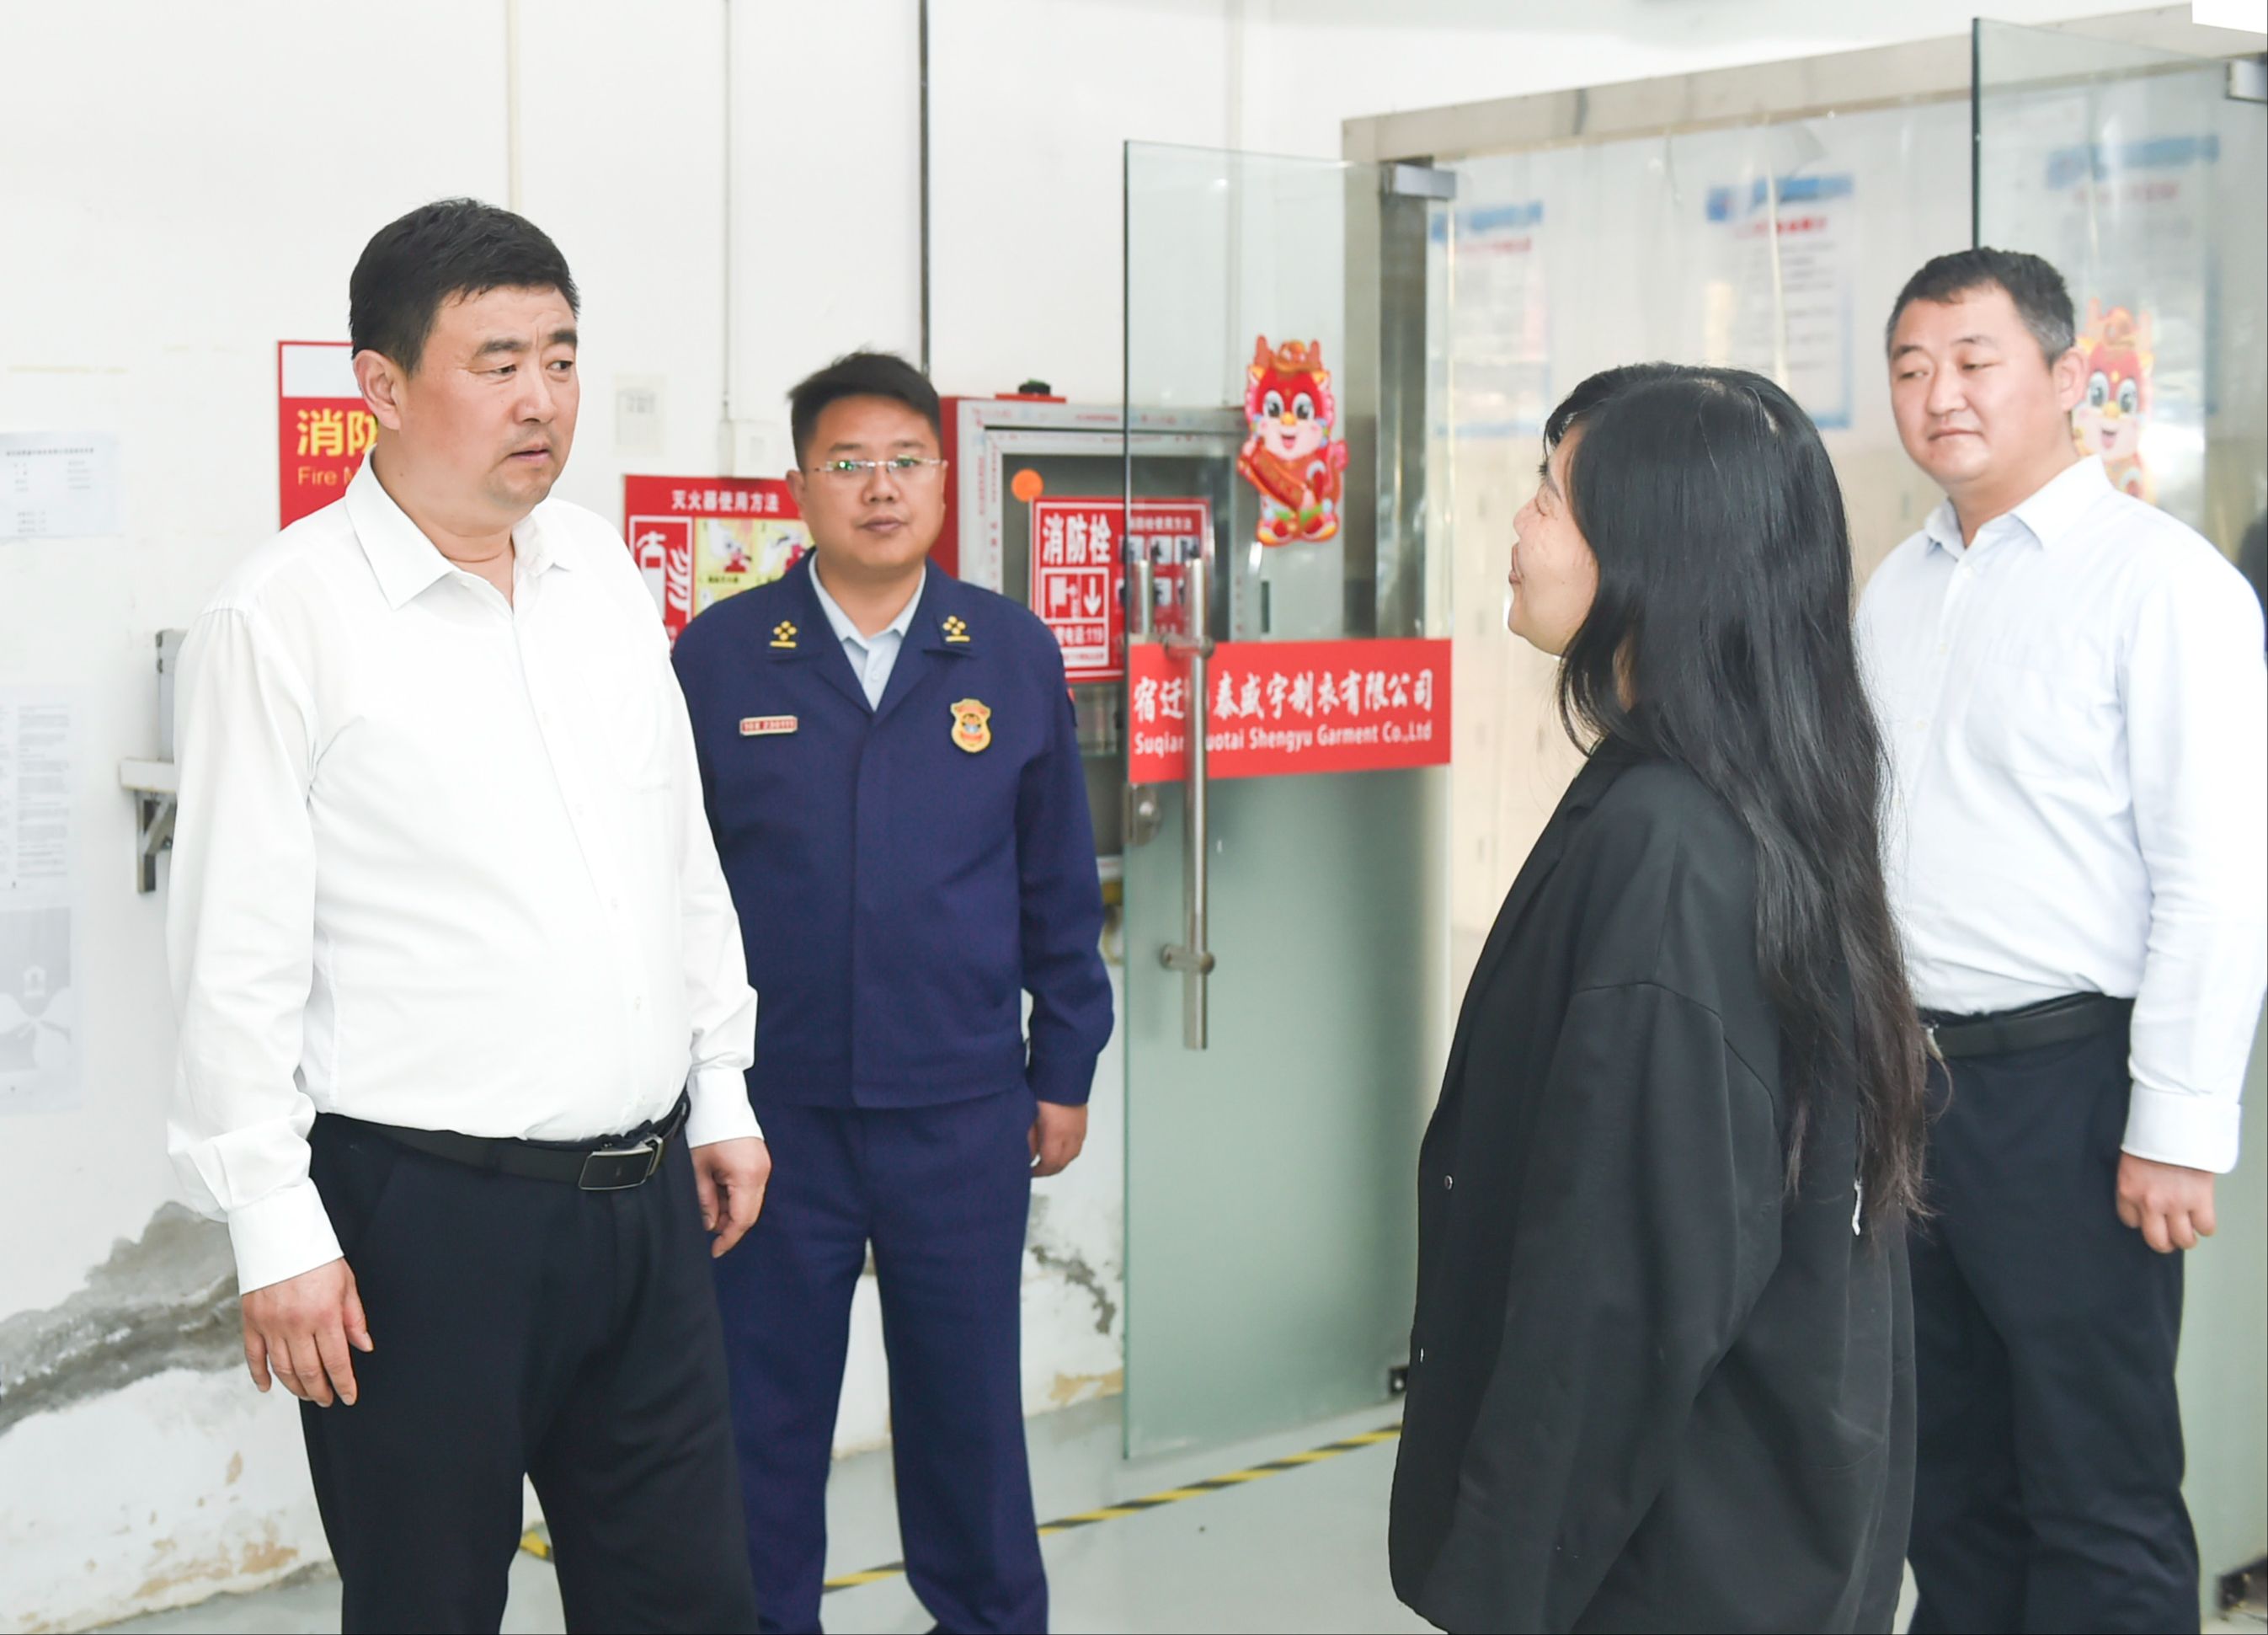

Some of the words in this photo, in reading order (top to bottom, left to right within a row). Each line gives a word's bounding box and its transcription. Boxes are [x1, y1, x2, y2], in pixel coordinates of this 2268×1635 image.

[297, 466, 338, 486] Fire
[671, 489, 780, 512] 灭火器使用方法
[1043, 512, 1111, 564] 消防栓
[1134, 668, 1433, 723] 宿迁泰盛宇制衣有限公司
[1205, 727, 1245, 751] uotai
[1249, 725, 1313, 753] Shengyu
[1317, 724, 1379, 747] Garment
